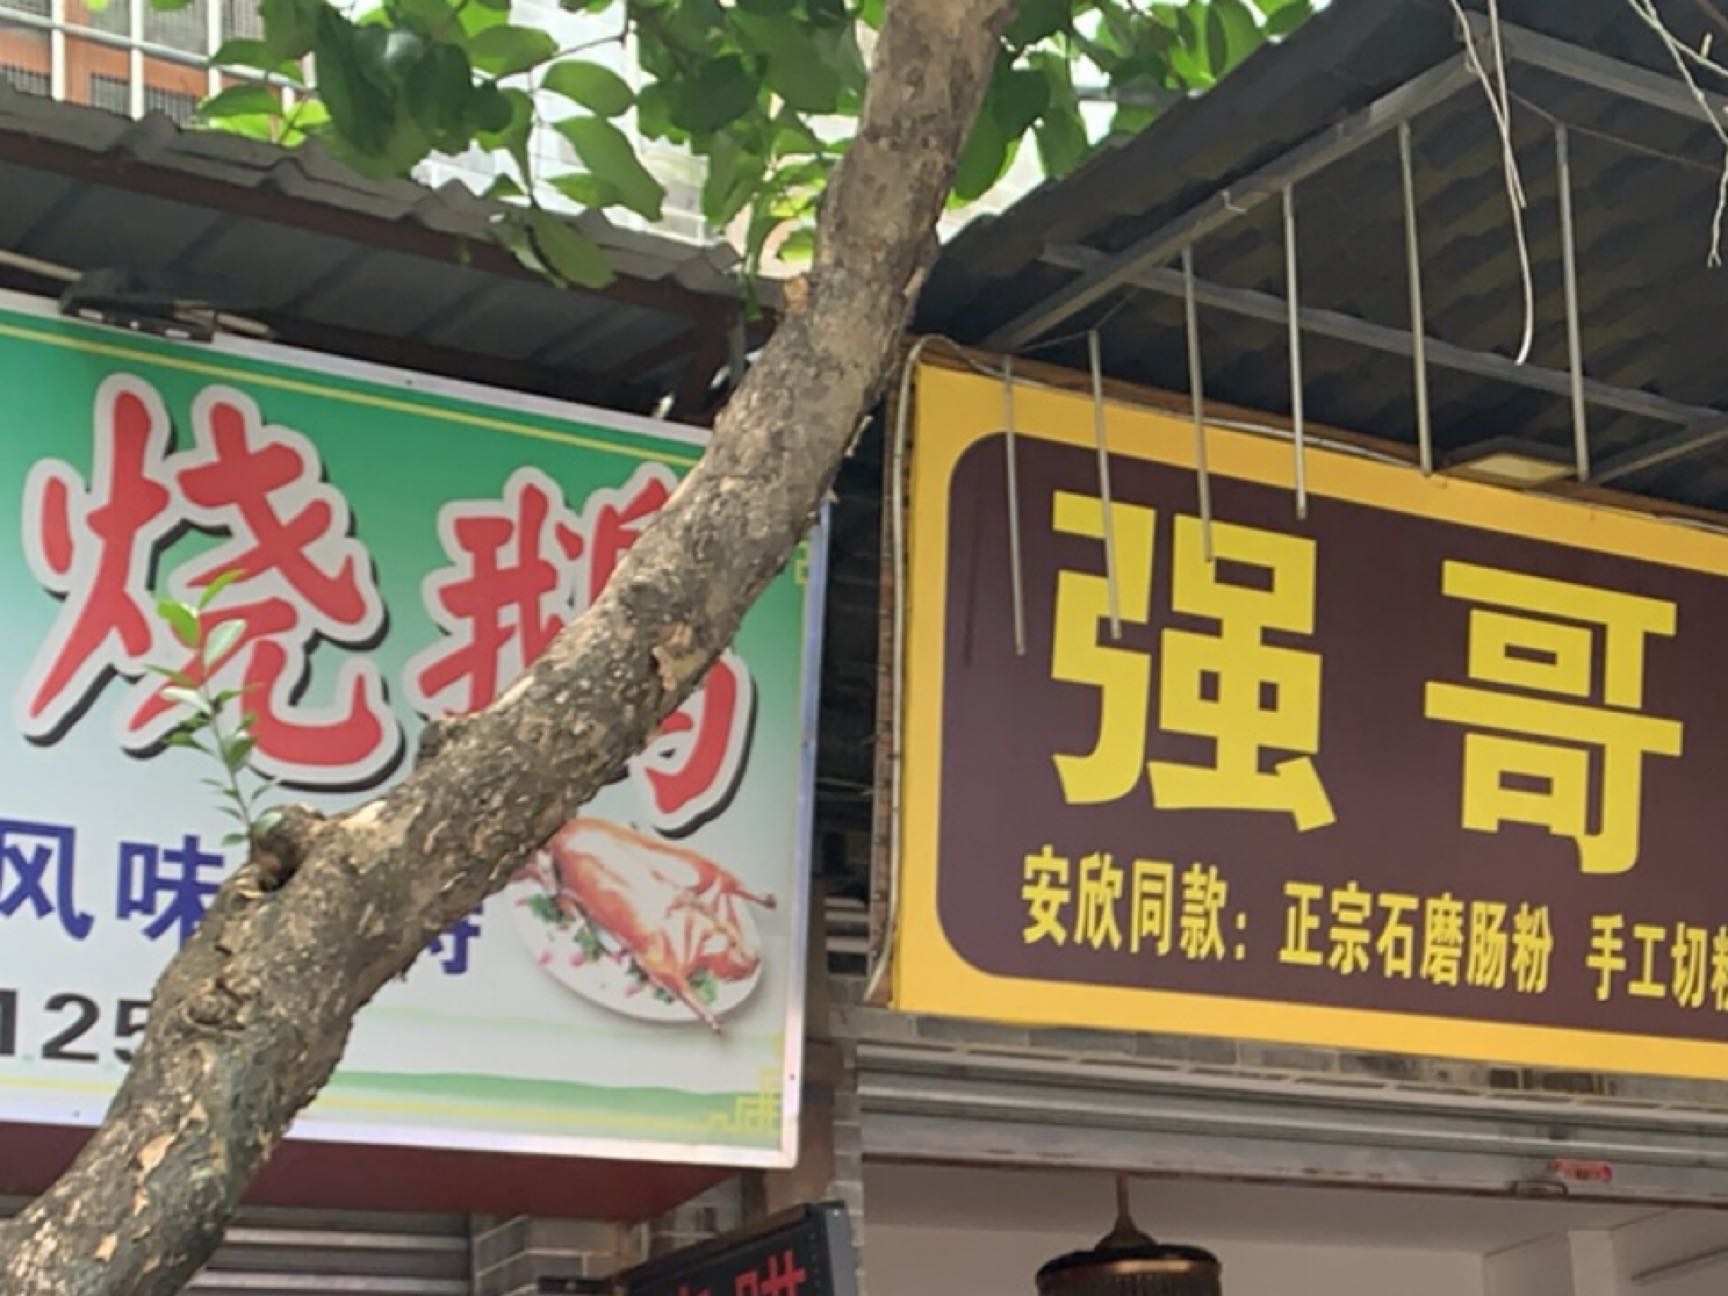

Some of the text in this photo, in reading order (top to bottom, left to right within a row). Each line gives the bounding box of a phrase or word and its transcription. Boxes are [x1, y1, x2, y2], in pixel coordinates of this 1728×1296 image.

[1279, 880, 1555, 995] 正宗石磨肠粉
